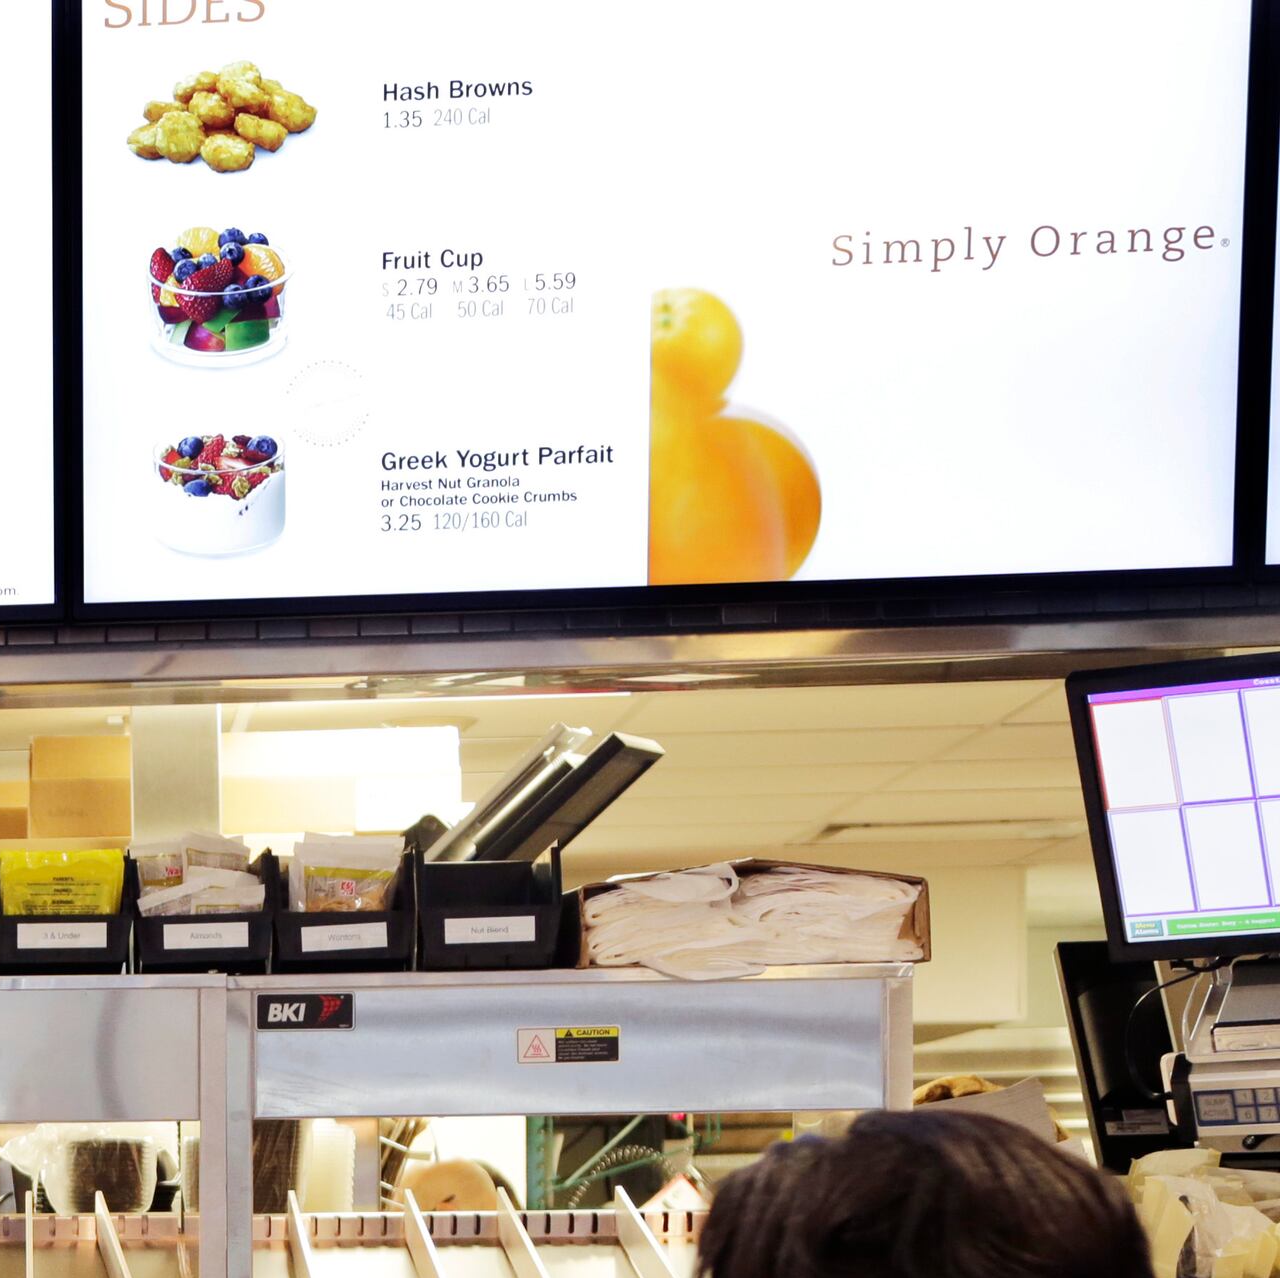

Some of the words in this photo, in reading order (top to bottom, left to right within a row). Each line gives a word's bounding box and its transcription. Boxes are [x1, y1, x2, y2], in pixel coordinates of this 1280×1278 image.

[105, 0, 265, 28] SIDES
[384, 82, 438, 101] Hash
[450, 80, 532, 98] Browns
[384, 111, 422, 128] 1.35
[434, 108, 462, 126] 240
[468, 108, 490, 125] Cal
[383, 251, 430, 270] Fruit
[441, 249, 483, 270] Cup
[832, 227, 1006, 272] Simply
[398, 278, 437, 296] 2.79
[469, 275, 509, 293] 3.65
[536, 272, 576, 290] 5.59
[382, 451, 447, 470] Greek
[457, 449, 528, 471] Yogurt
[539, 445, 613, 464] Parfait
[382, 480, 432, 491] Harvest
[438, 478, 461, 489] Nut
[467, 476, 519, 488] Granola
[381, 499, 394, 507] or
[400, 495, 467, 507] Chocolate
[472, 493, 519, 504] Cookie
[524, 491, 577, 502] Crumbs
[381, 514, 421, 531] 3.25
[435, 511, 499, 531] 120/160
[505, 511, 527, 527] Cal
[50, 931, 56, 939] &
[471, 926, 484, 934] Nut
[267, 1002, 306, 1022] BKI
[576, 1028, 611, 1037] CAUTION
